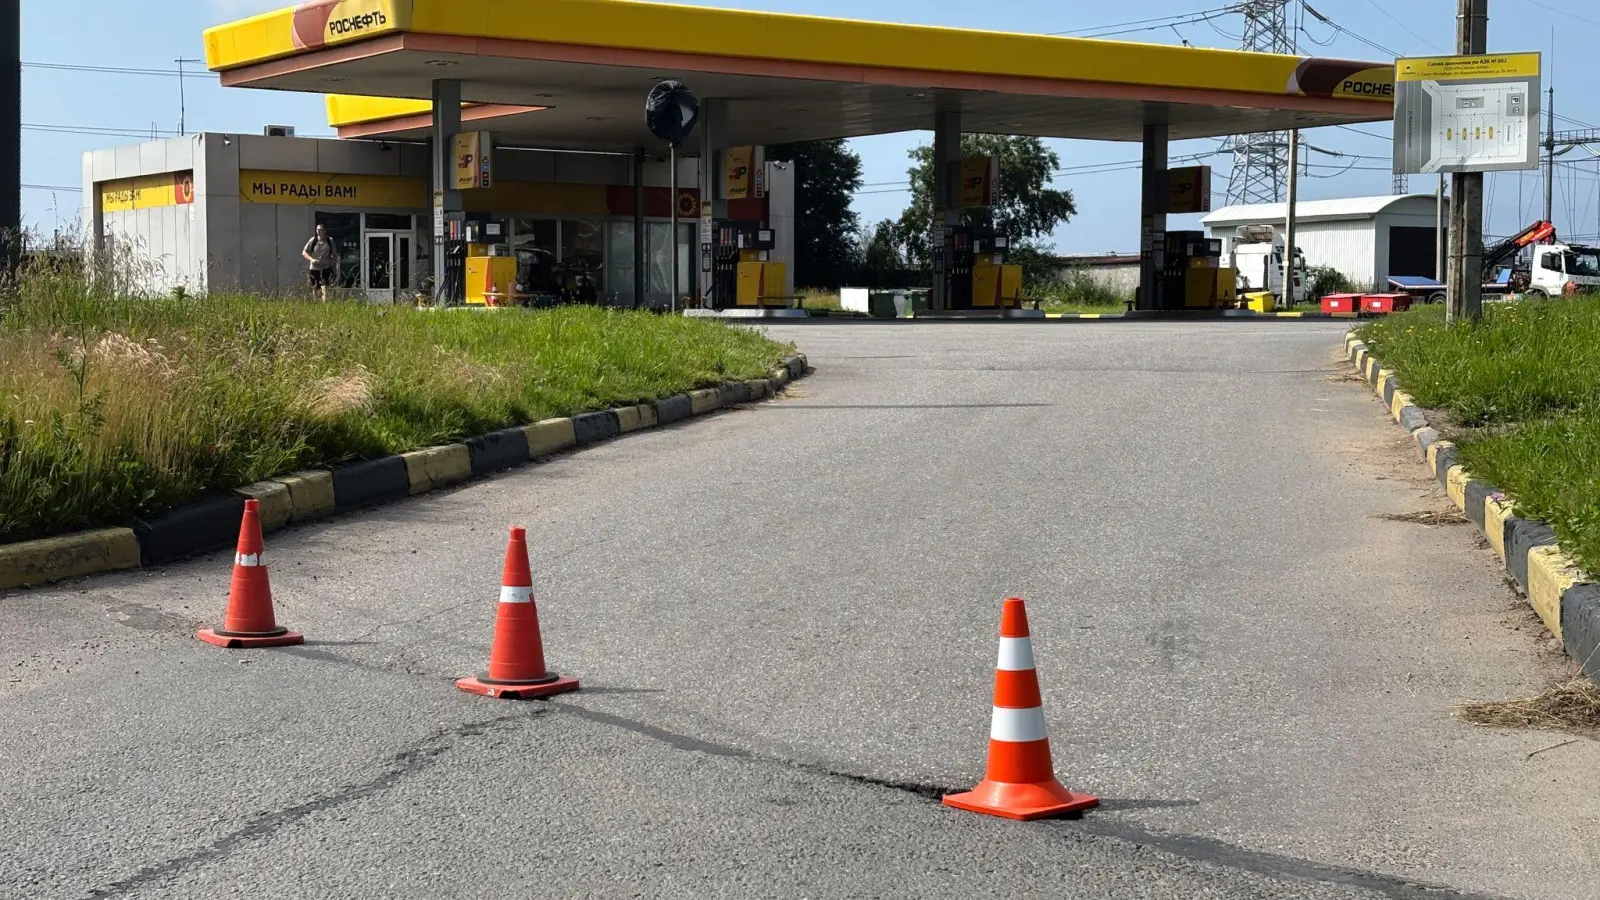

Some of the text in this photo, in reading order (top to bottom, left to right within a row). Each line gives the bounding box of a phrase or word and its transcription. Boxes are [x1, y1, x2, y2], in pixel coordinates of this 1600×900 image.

[329, 10, 387, 35] РОСНЕФТЬ
[1342, 80, 1395, 95] РОСНЕ
[252, 182, 357, 198] МЫ РАДЫ ВАМ!
